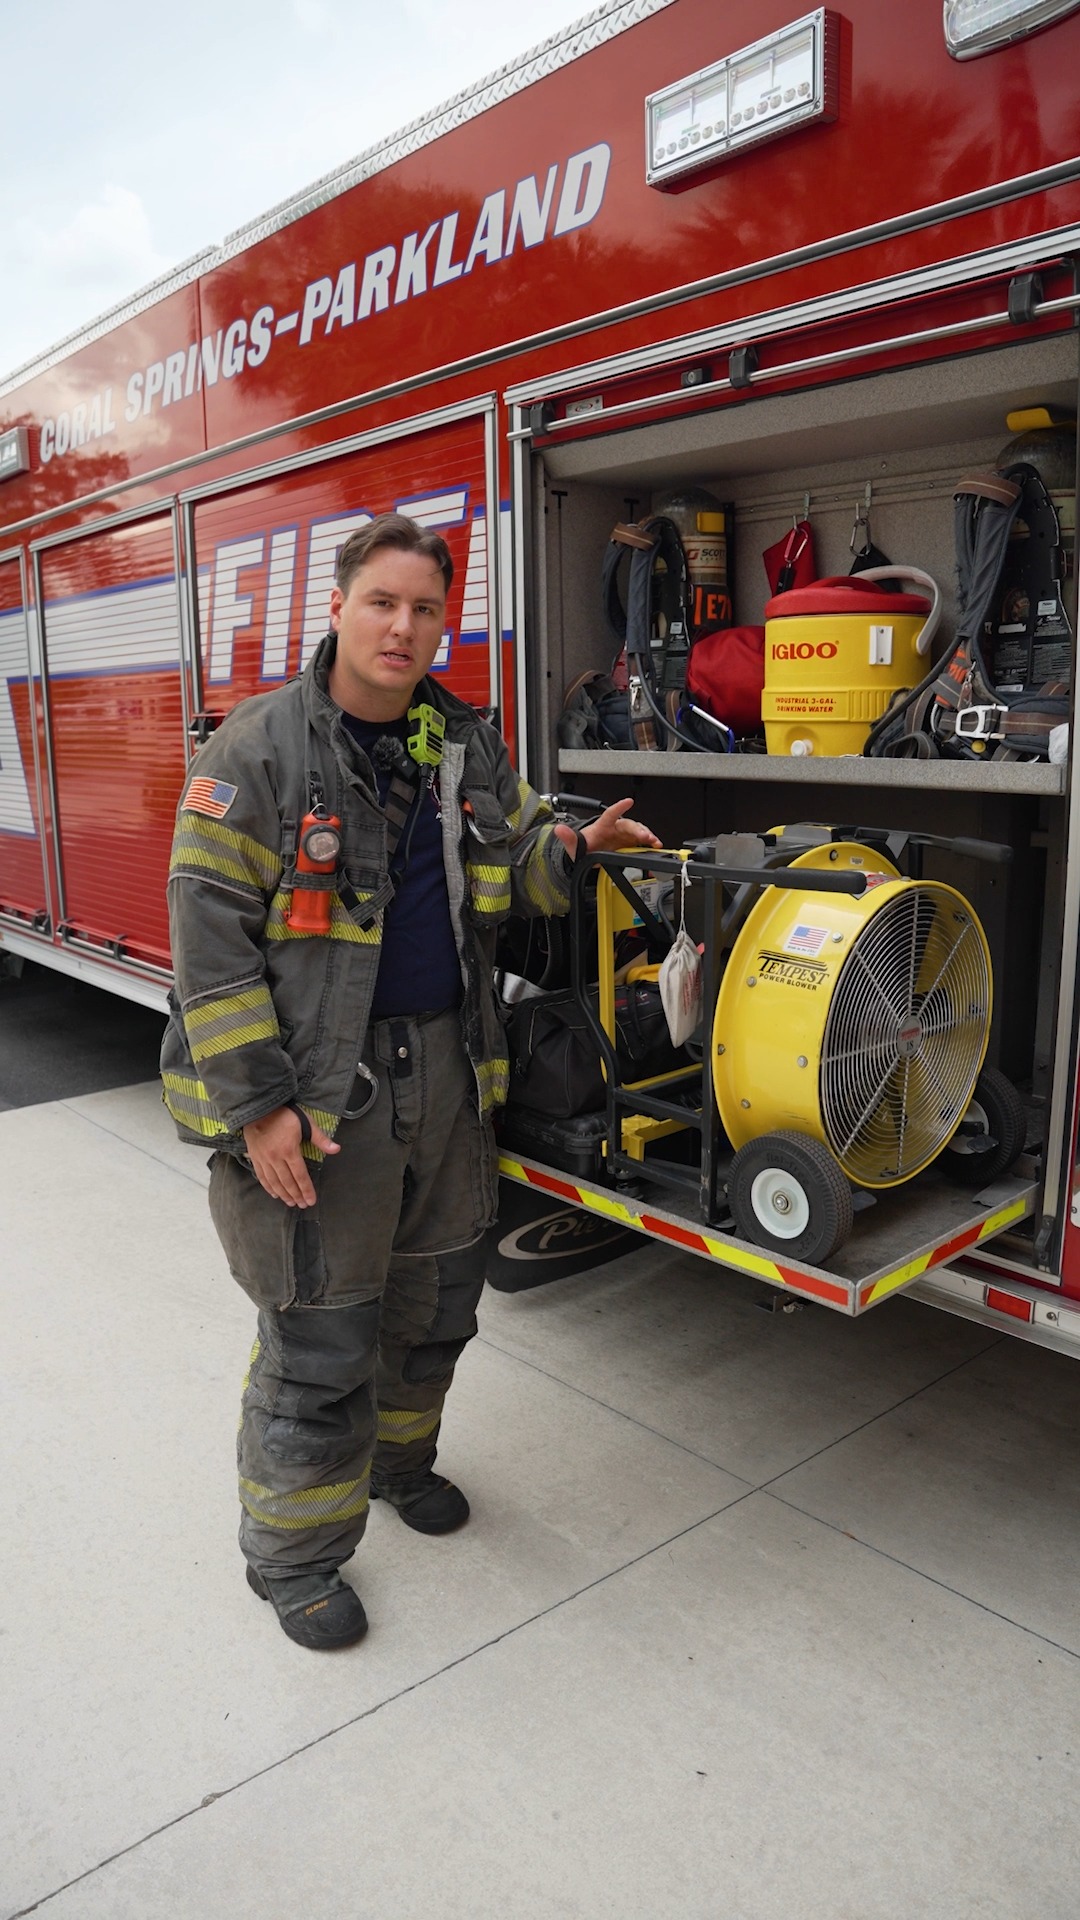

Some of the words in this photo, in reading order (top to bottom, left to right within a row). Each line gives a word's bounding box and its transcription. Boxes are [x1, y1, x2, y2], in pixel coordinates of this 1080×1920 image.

[40, 387, 116, 464] CORAL
[772, 642, 838, 660] IGLOO
[776, 705, 807, 713] DRINKING
[758, 956, 830, 986] TEMPEST
[759, 972, 785, 984] POWER
[786, 979, 818, 991] BLOWER
